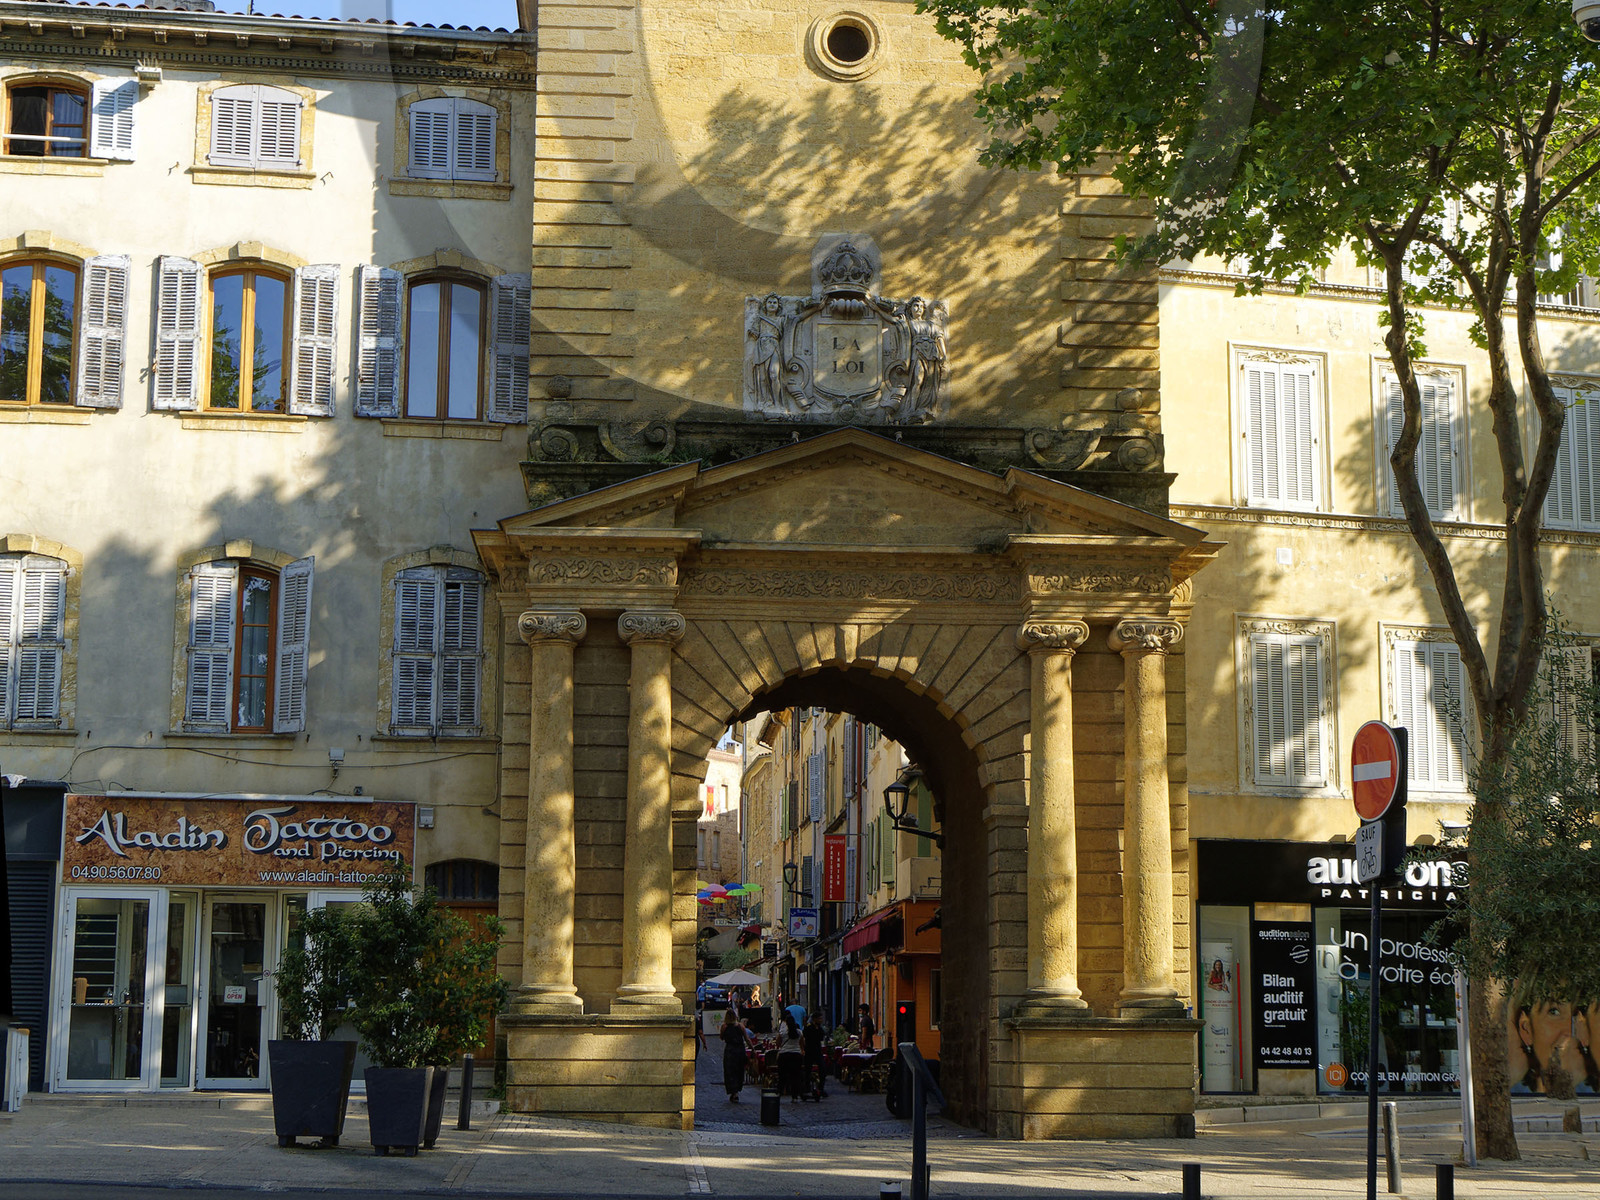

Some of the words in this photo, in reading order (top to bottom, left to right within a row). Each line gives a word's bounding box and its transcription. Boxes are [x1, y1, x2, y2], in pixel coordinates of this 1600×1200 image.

[833, 337, 860, 350] LA
[833, 361, 864, 373] LOI
[75, 809, 225, 857] Aladin
[243, 806, 392, 851] Tattoo
[1361, 826, 1376, 842] SAUF
[274, 842, 310, 857] and
[321, 842, 399, 864] Piercing
[71, 865, 161, 880] 04.90.56.07.80
[1322, 888, 1457, 901] PATRICIA
[1330, 927, 1368, 951] un
[1338, 955, 1359, 980] à
[1262, 974, 1295, 987] Bilan
[1263, 991, 1304, 1004] auditif
[1260, 1047, 1270, 1056] 04
[1271, 1047, 1281, 1056] 42
[1282, 1047, 1292, 1056] 48
[1292, 1047, 1303, 1056] 40
[1304, 1047, 1312, 1056] 13
[1329, 1070, 1342, 1081] ICI
[1350, 1071, 1387, 1081] CONEIL
[1388, 1072, 1399, 1081] EN
[1401, 1072, 1440, 1082] AUDITION
